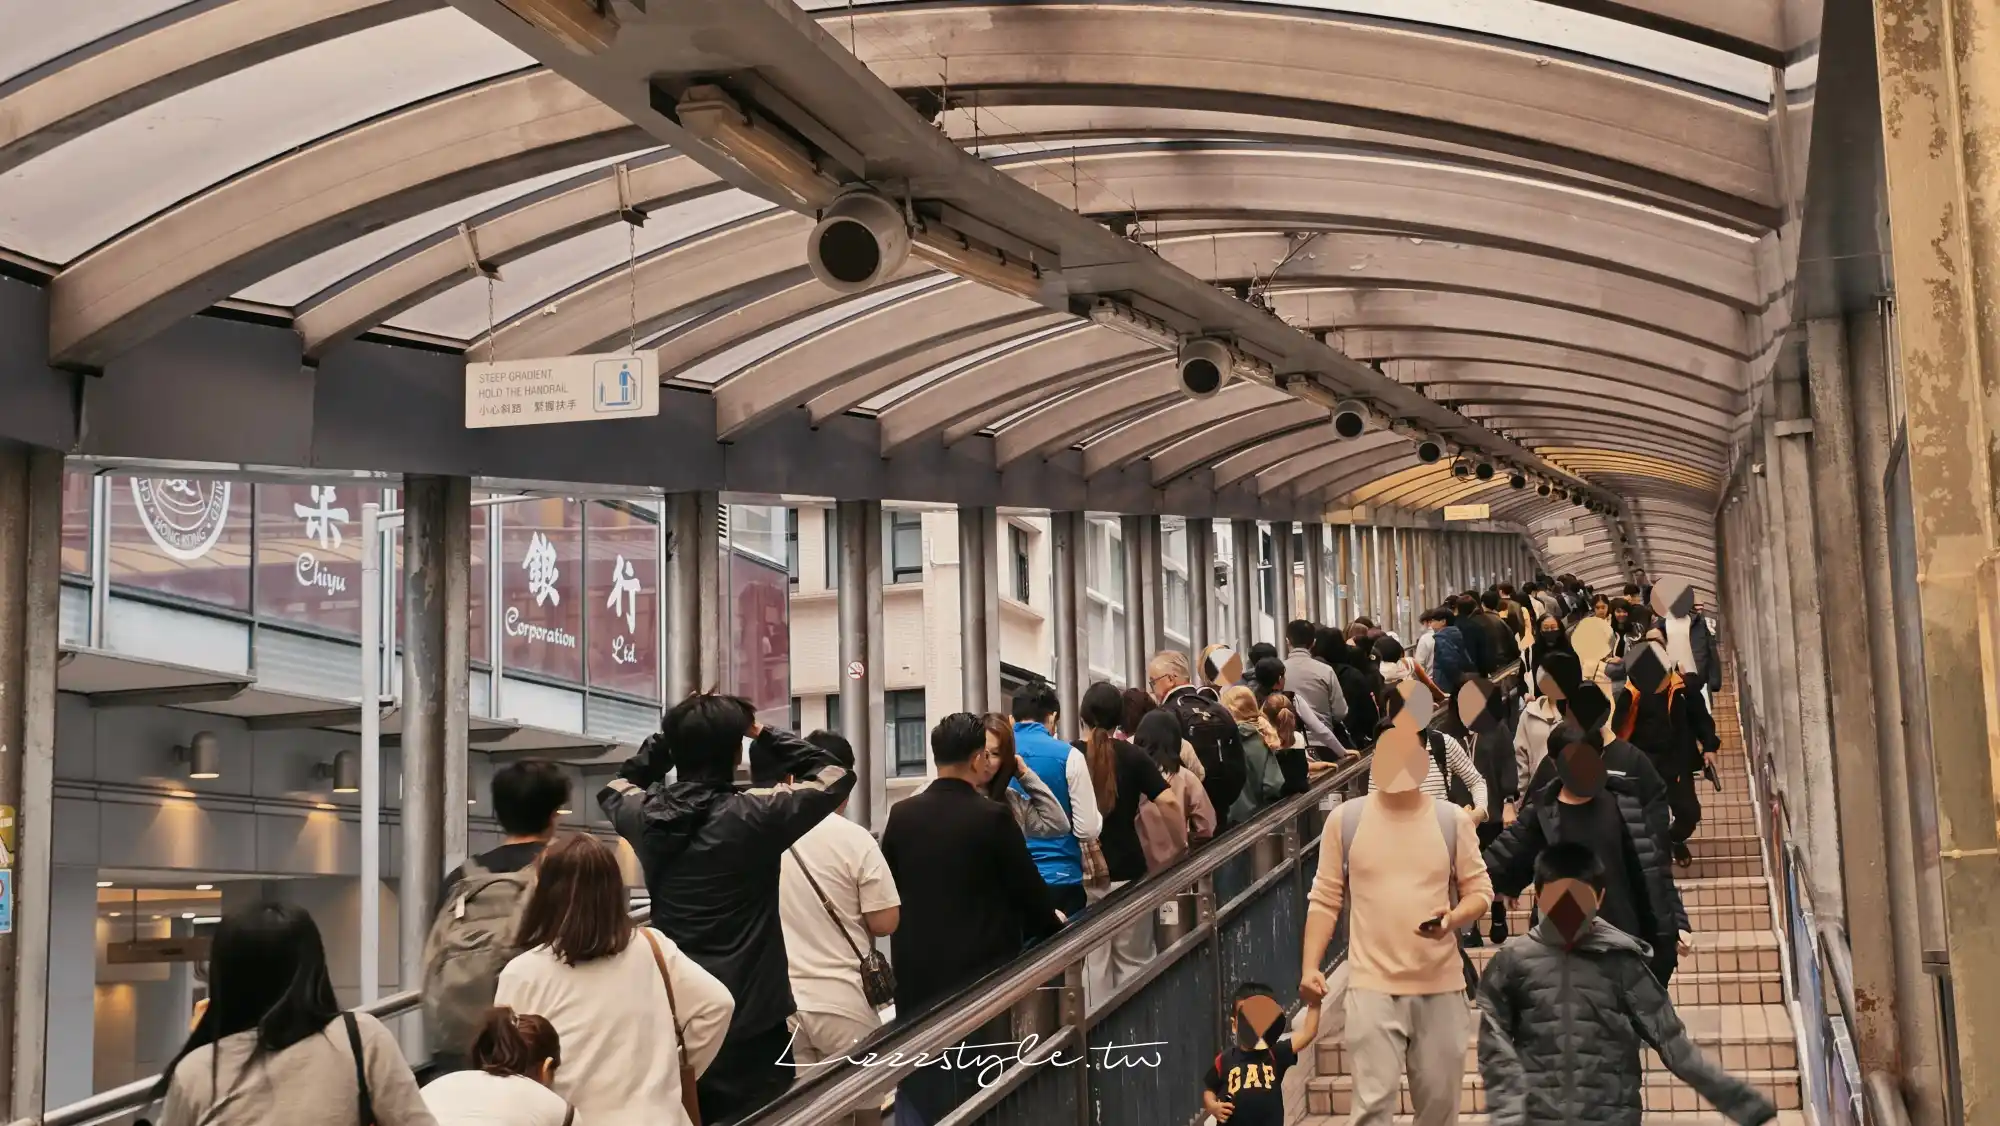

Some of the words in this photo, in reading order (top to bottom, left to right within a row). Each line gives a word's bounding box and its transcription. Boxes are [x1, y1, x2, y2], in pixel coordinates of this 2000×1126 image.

[479, 372, 506, 383] STEEP
[479, 388, 503, 398] HOLD
[506, 386, 522, 397] THE
[524, 382, 569, 396] HANDRAIL
[479, 403, 522, 416] 小心斜路
[154, 515, 181, 546] HONG
[182, 527, 206, 547] KONG
[296, 552, 346, 596] Chiyu
[505, 606, 576, 648] Corporation
[611, 635, 638, 664] Ltd.
[1227, 1063, 1276, 1094] GAP
